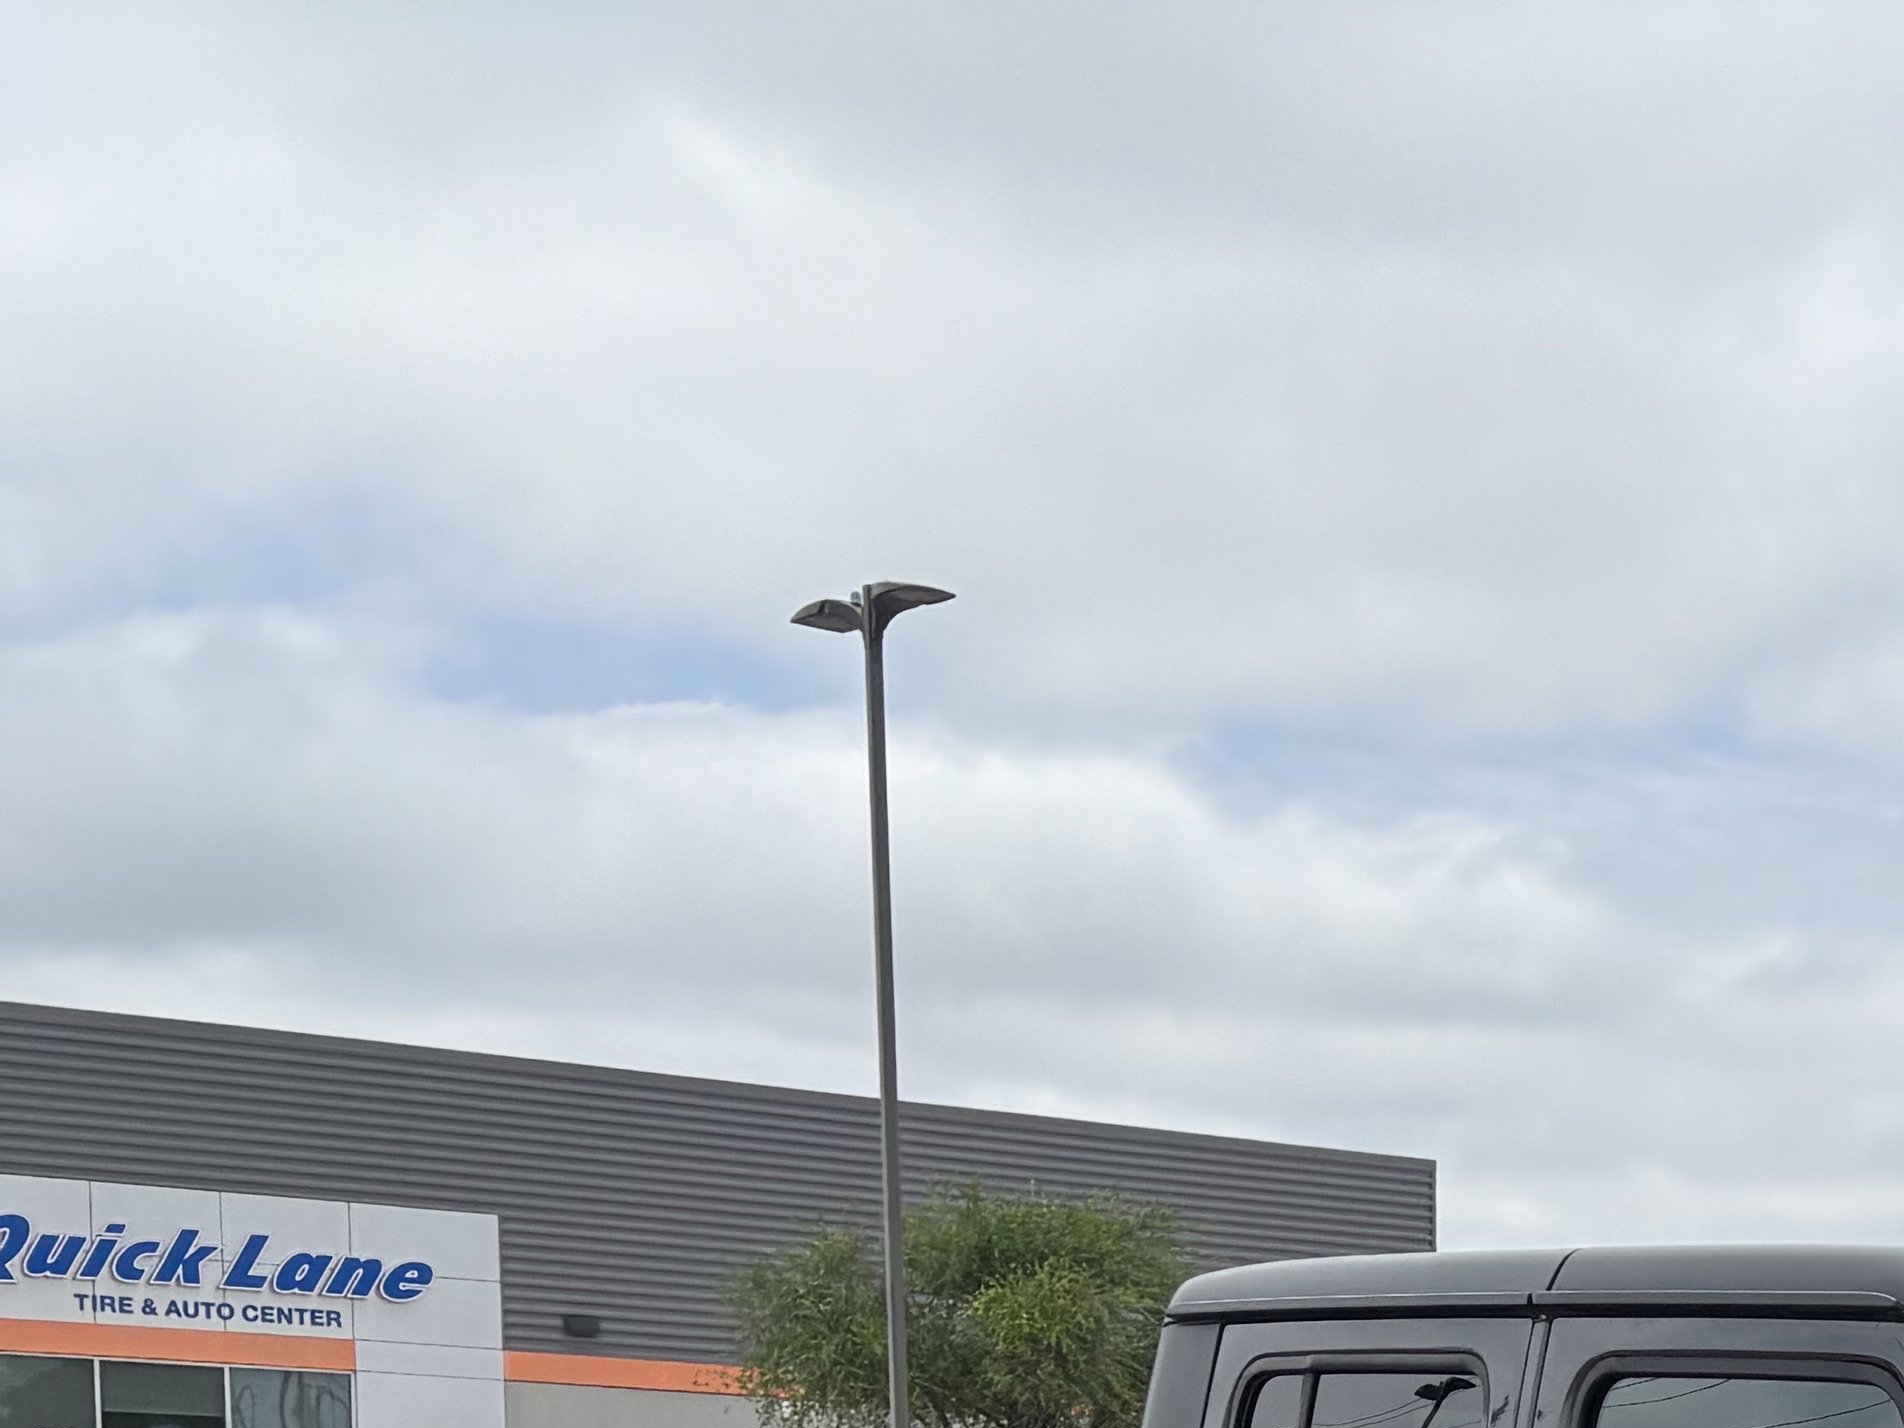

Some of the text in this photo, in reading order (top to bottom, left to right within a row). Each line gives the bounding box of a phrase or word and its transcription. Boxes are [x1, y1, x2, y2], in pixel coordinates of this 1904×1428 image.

[220, 1233, 434, 1303] Lane
[74, 1294, 343, 1328] TIRE & AUTO CENTER
